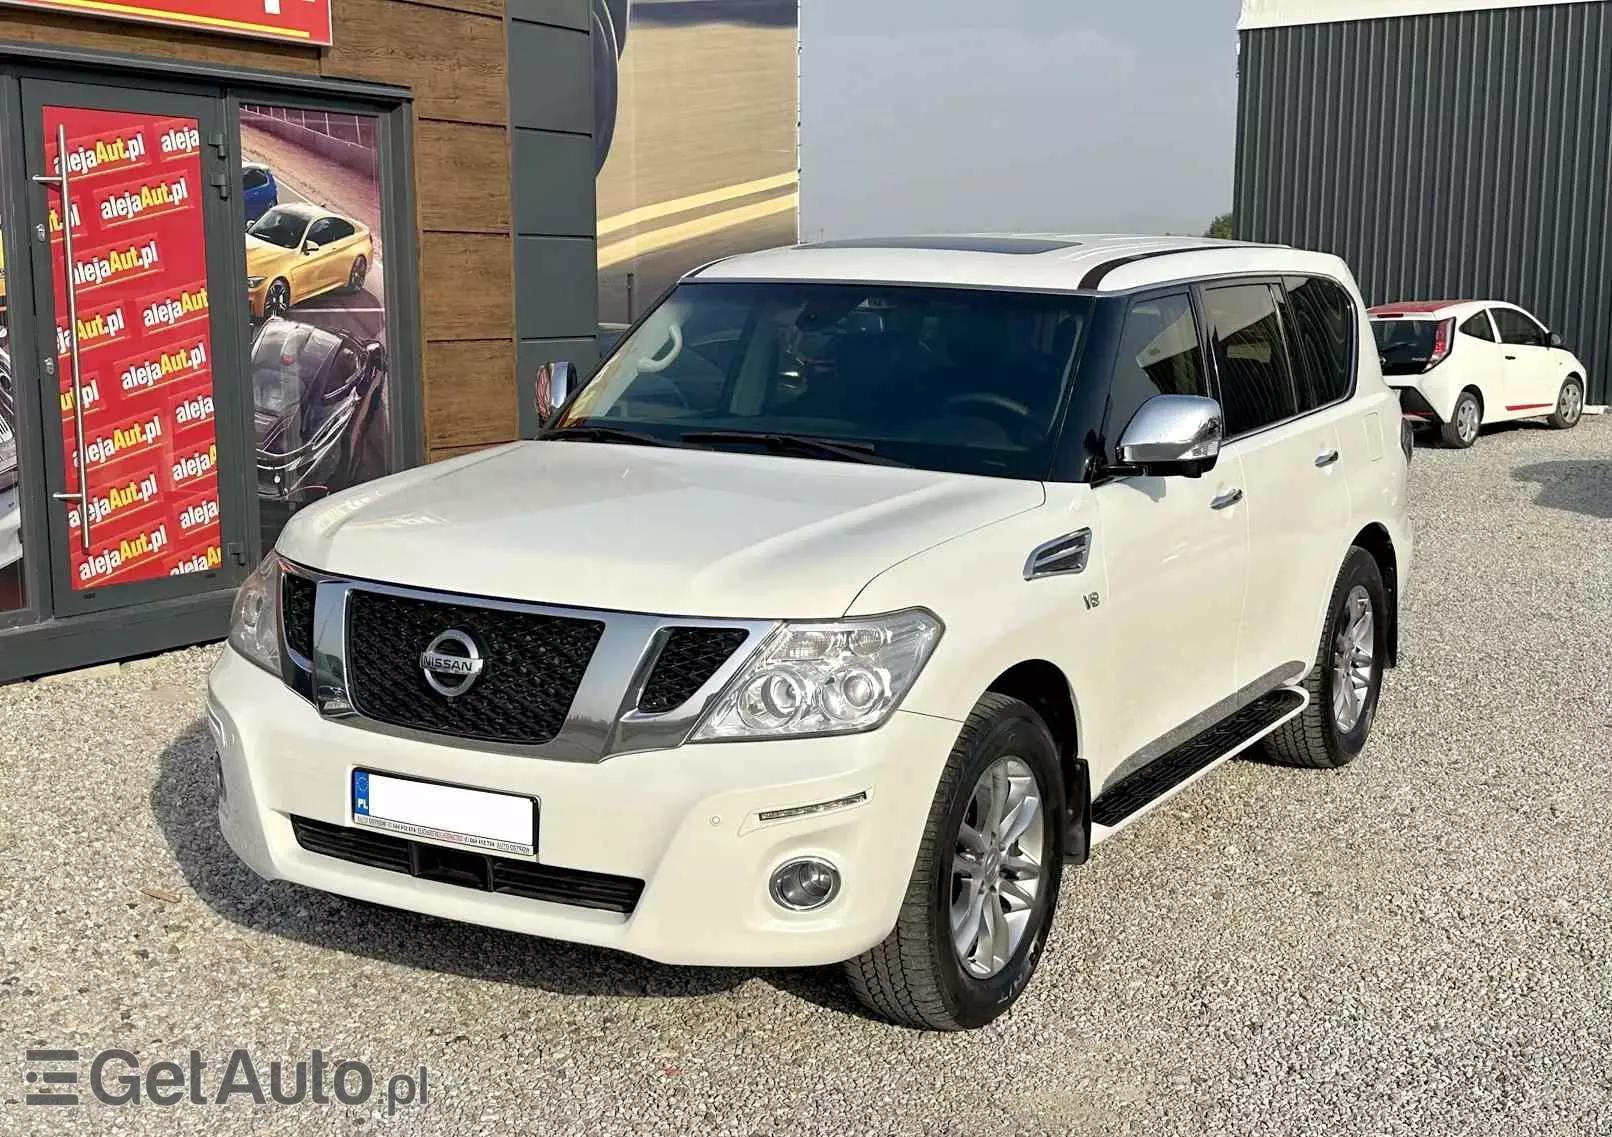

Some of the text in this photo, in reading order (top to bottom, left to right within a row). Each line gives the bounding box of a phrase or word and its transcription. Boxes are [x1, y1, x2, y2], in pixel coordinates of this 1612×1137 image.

[161, 126, 199, 152] aleja
[101, 177, 188, 218] alejaAut.pl
[121, 342, 207, 390] alejaAut.pl
[175, 395, 214, 423] aleja
[79, 525, 168, 580] alejaAut.pl
[1083, 592, 1100, 610] V8
[423, 654, 473, 672] NISSAN
[358, 798, 369, 809] PL
